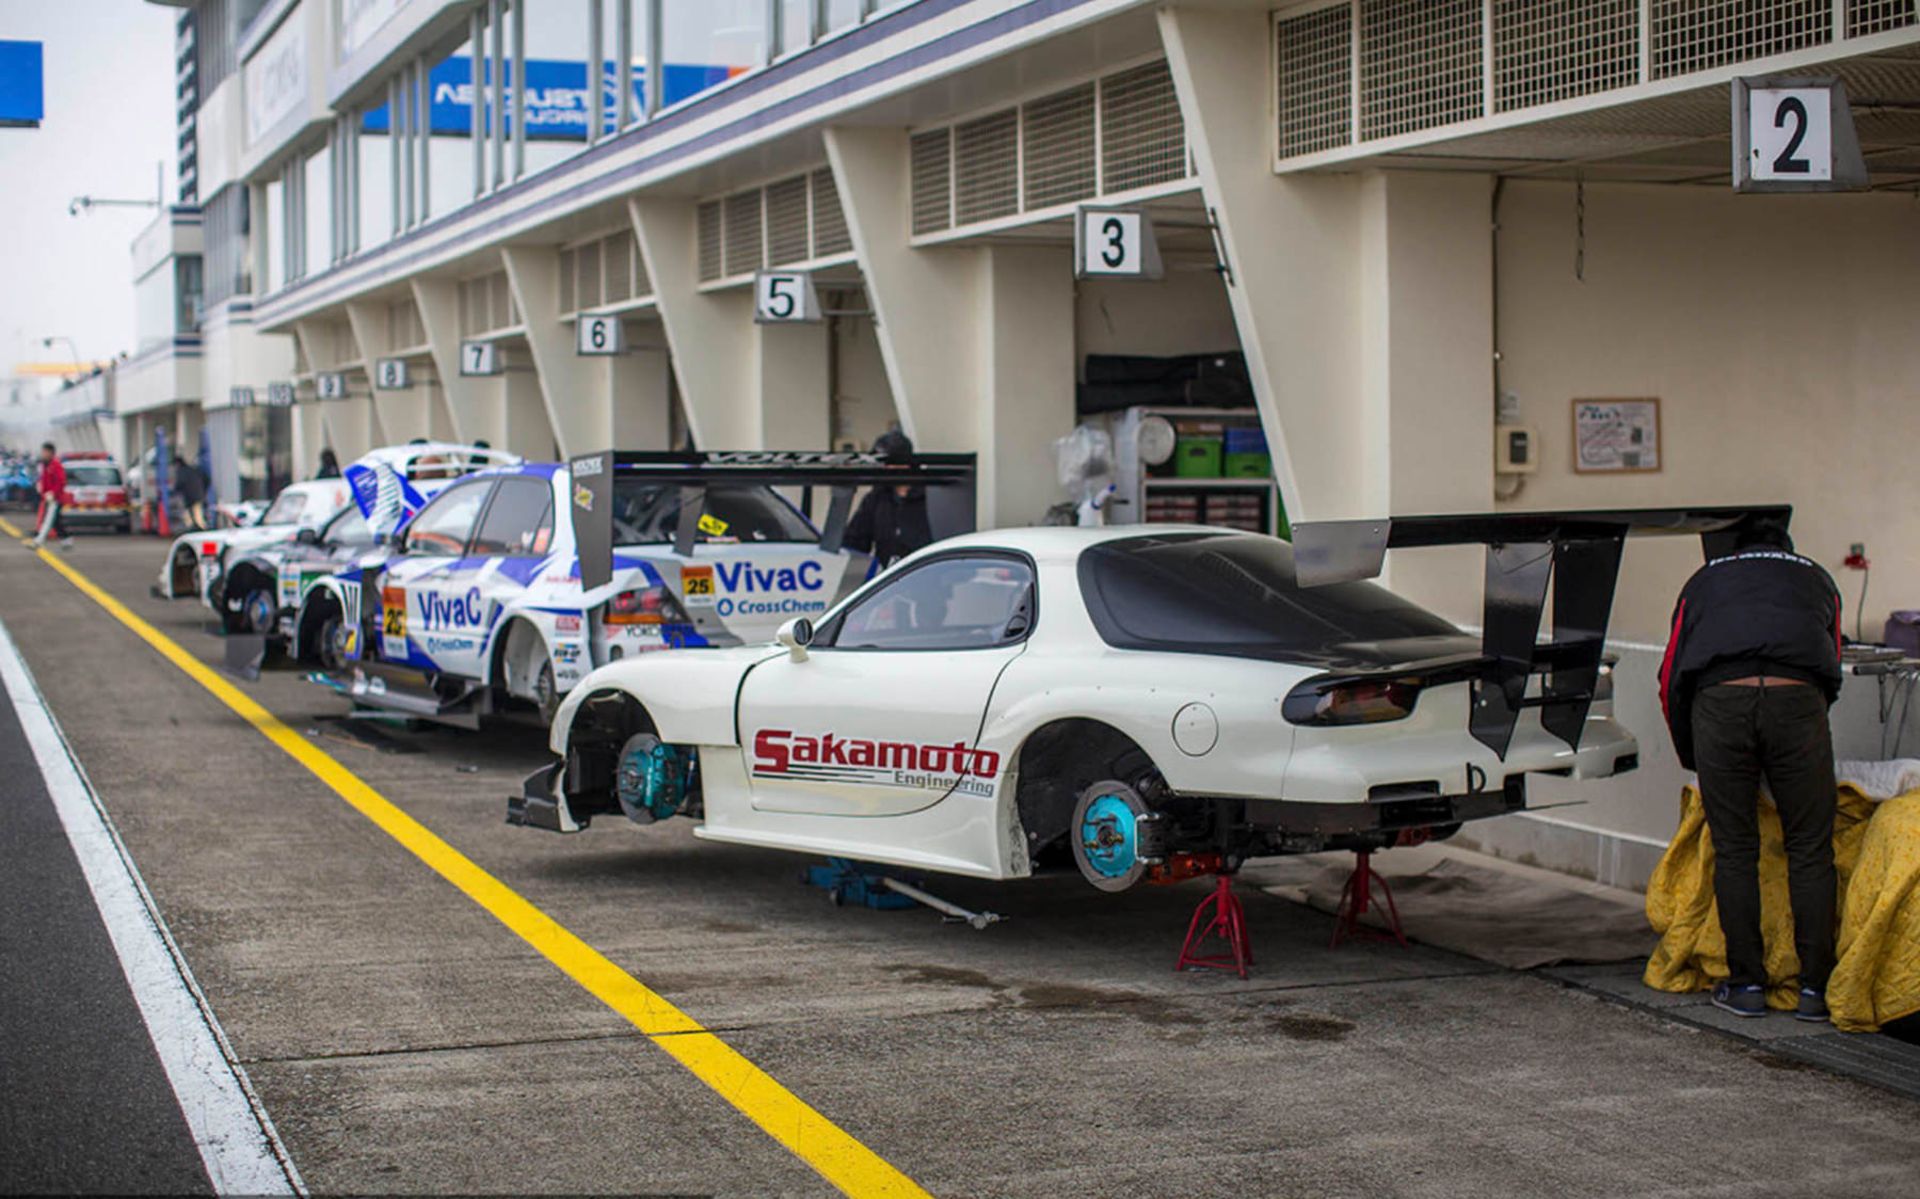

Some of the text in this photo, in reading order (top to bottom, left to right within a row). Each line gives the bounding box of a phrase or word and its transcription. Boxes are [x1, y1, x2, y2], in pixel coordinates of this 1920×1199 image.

[1773, 96, 1810, 173] 2
[1102, 217, 1125, 268] 3
[768, 277, 795, 318] 5
[591, 320, 606, 349] 6
[472, 346, 484, 370] 7
[386, 362, 396, 384] 8
[706, 452, 889, 465] VOLTEX
[687, 579, 710, 595] 25
[715, 561, 824, 593] VivaC
[417, 586, 482, 631] VivaC
[738, 599, 826, 615] CrossChem
[753, 729, 1000, 779] Sakamoto
[894, 770, 995, 798] Engineering
